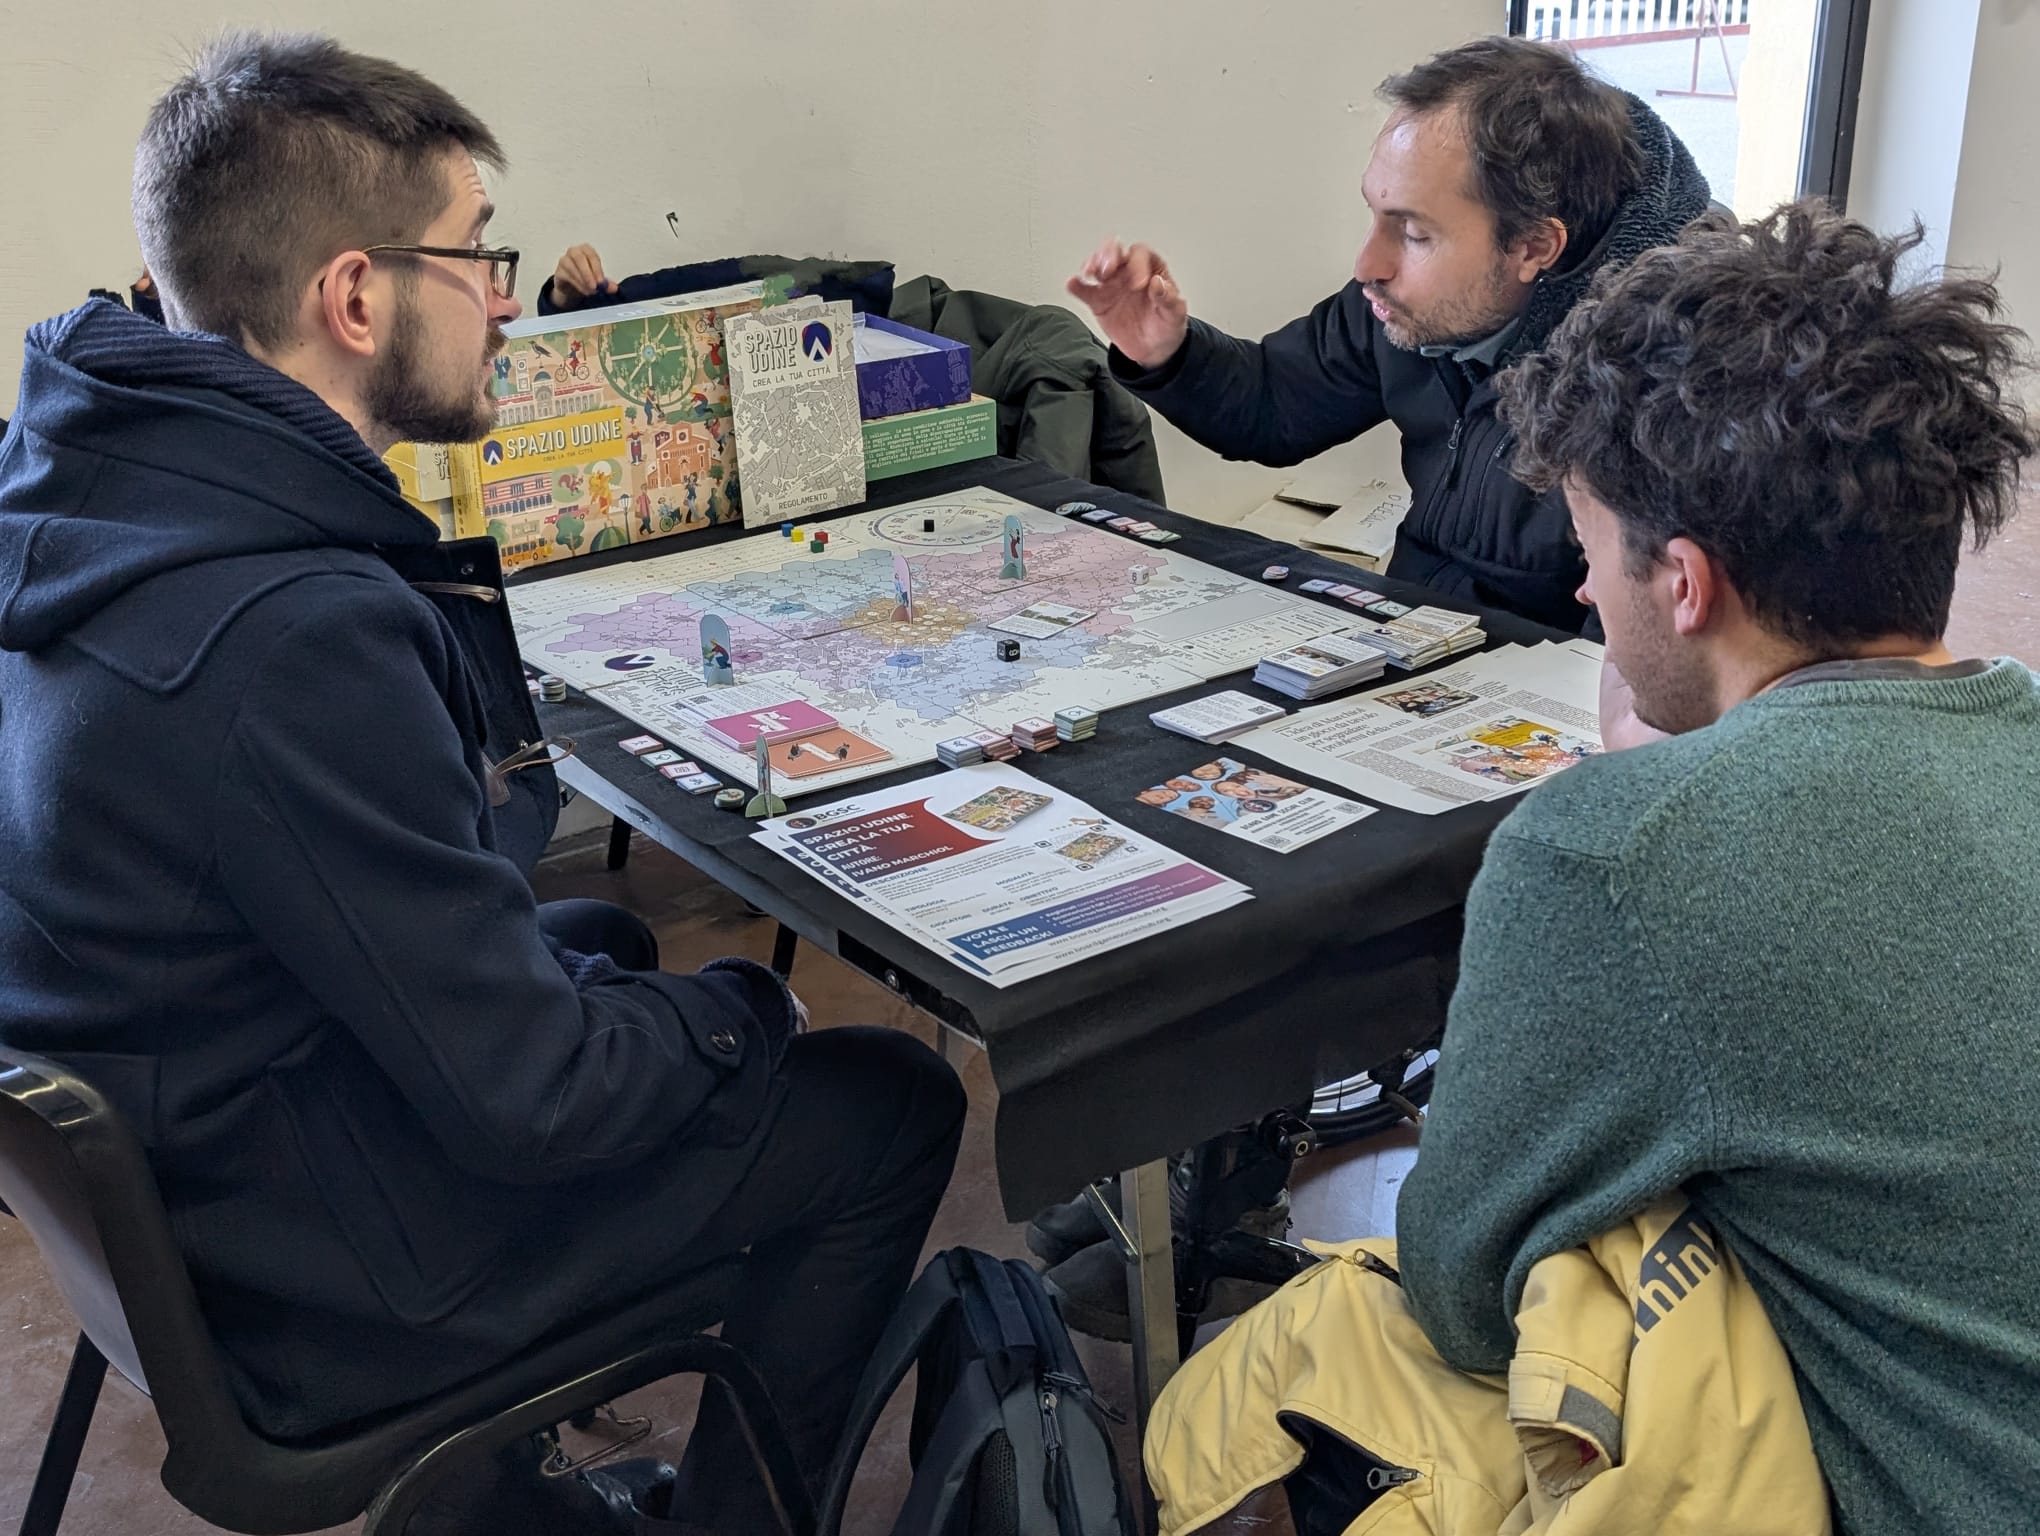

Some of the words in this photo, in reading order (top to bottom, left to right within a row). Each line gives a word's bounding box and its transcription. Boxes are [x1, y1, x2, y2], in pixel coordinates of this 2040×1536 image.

[745, 325, 797, 353] SPAZIO
[751, 347, 796, 373] UDINE
[753, 379, 772, 388] CREA
[775, 376, 785, 384] LA
[789, 371, 803, 381] TUA
[807, 365, 831, 378] CITTÀ
[506, 429, 567, 460] SPAZIO
[570, 418, 622, 447] UDINE
[778, 492, 828, 510] REGOLAMENTO
[814, 804, 861, 820] BGSC
[803, 824, 861, 845] SPAZIO
[861, 812, 914, 829] UDINE.
[814, 838, 858, 853] CREA
[859, 831, 882, 841] LA
[880, 822, 914, 836] TUA
[826, 844, 878, 862] CITTÀ.
[840, 855, 883, 870] AUTORE:
[852, 862, 892, 877] IVANO
[890, 845, 954, 868] MARCHIOL
[865, 866, 929, 888] DESCRIZIONE
[961, 928, 998, 943] VOTA
[998, 926, 1008, 934] E
[970, 932, 1019, 948] LASCIA
[1018, 926, 1038, 936] UN
[983, 931, 1054, 955] FEEDBACK!
